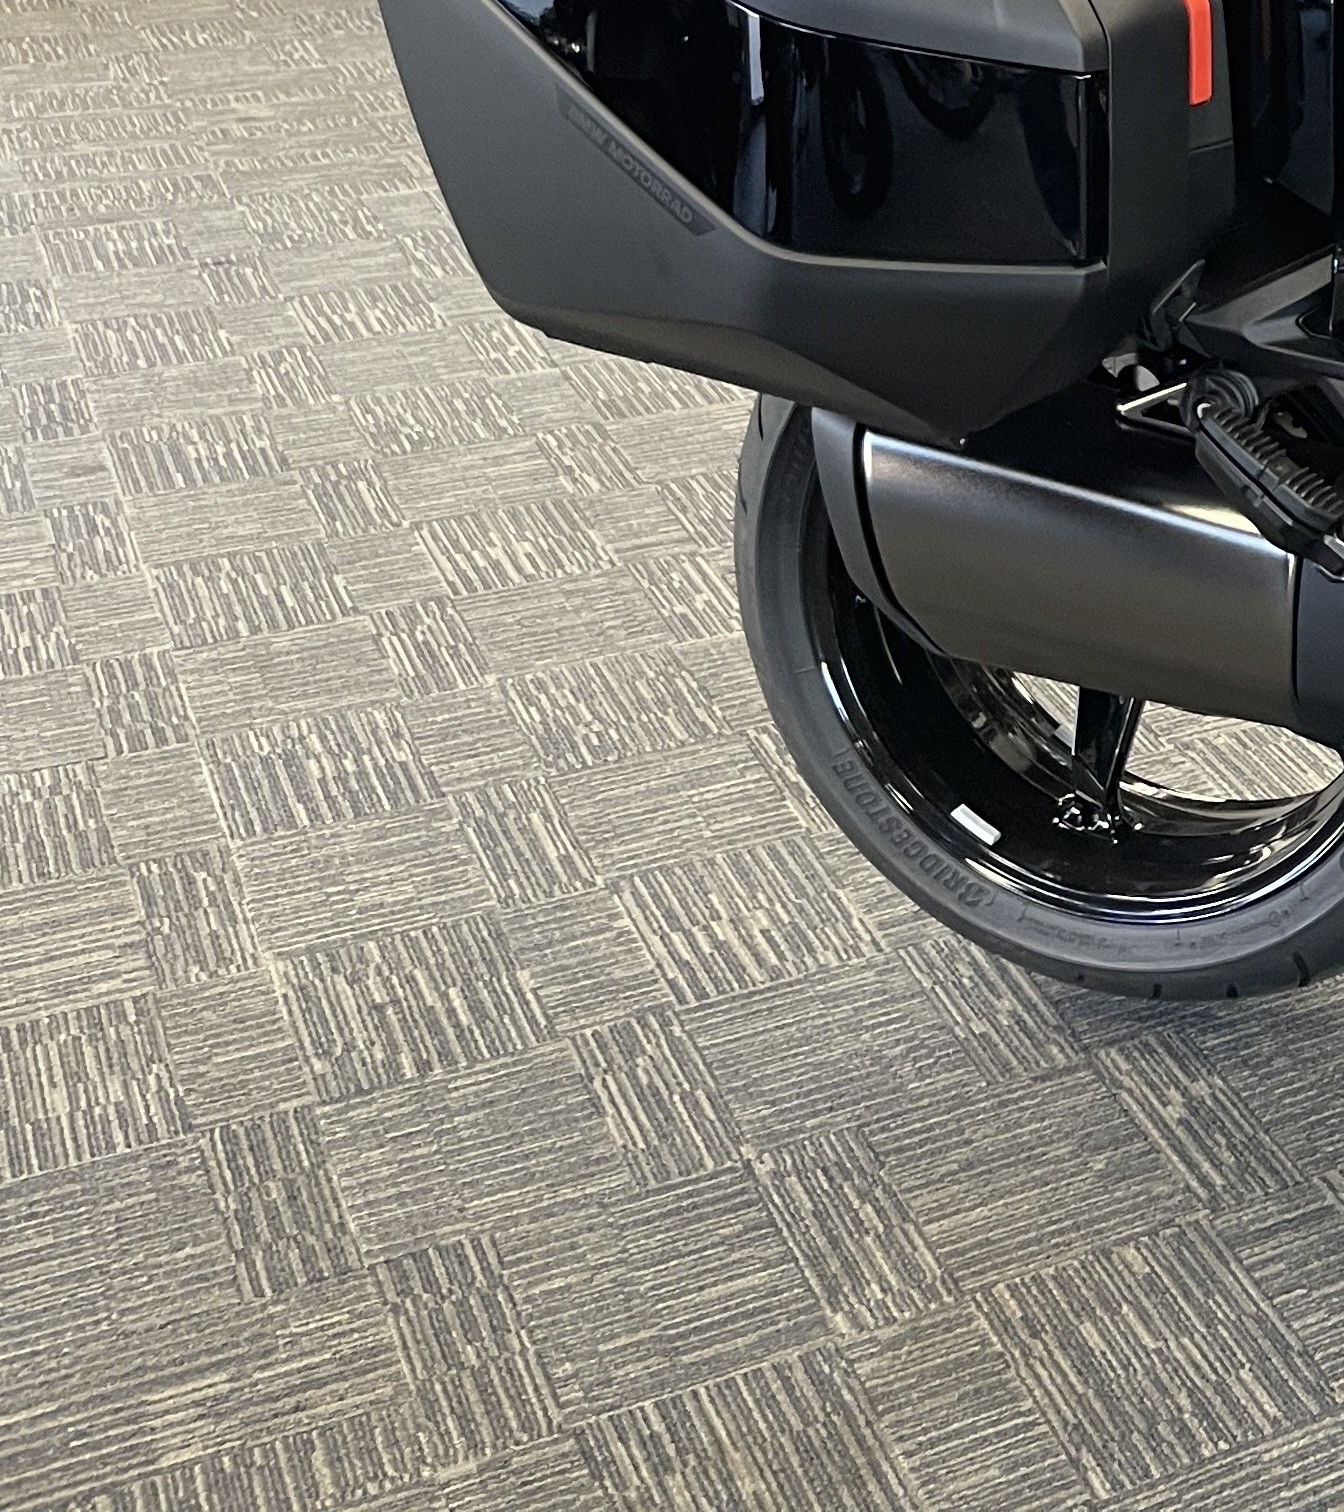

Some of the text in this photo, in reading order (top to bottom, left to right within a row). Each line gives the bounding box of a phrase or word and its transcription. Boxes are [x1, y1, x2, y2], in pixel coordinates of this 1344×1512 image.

[566, 104, 694, 223] BMW MOTORRAD
[832, 759, 990, 908] BRIDGESTONE
